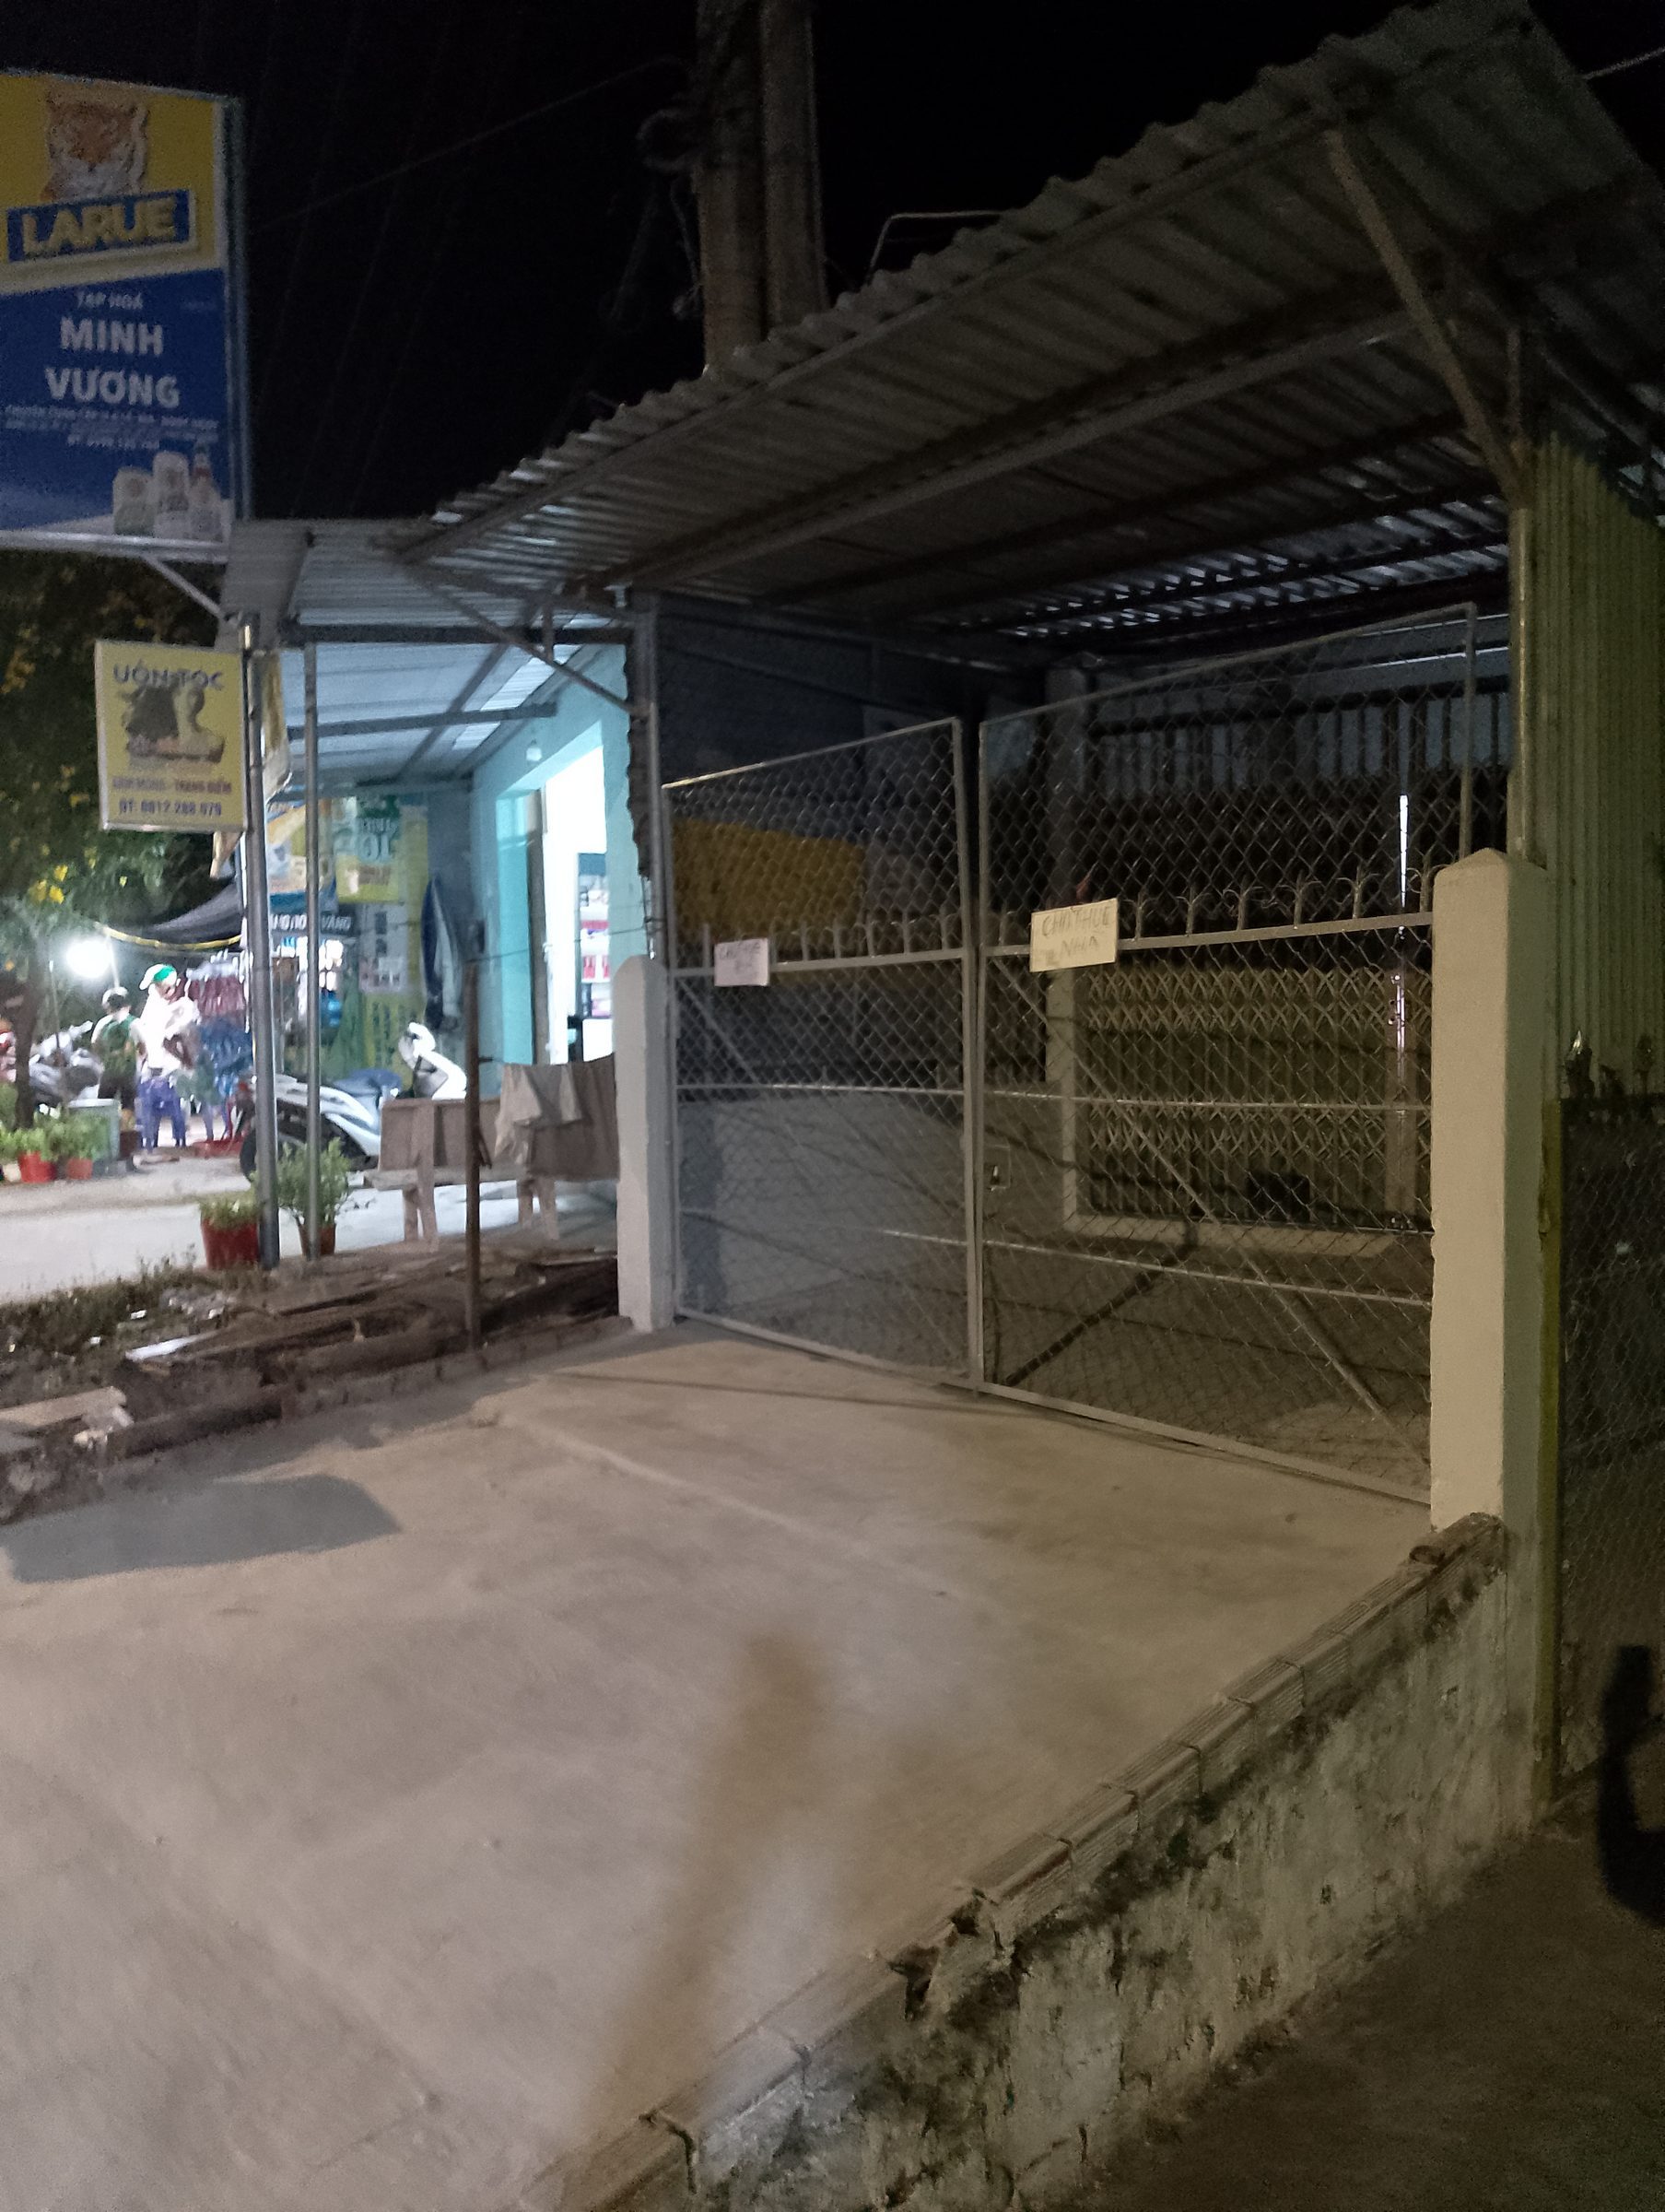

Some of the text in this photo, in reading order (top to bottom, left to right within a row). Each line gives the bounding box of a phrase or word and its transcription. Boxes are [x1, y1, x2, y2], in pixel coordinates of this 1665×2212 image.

[22, 196, 176, 253] LARUE
[60, 316, 164, 355] MINH
[45, 367, 181, 408] VƯƠNG
